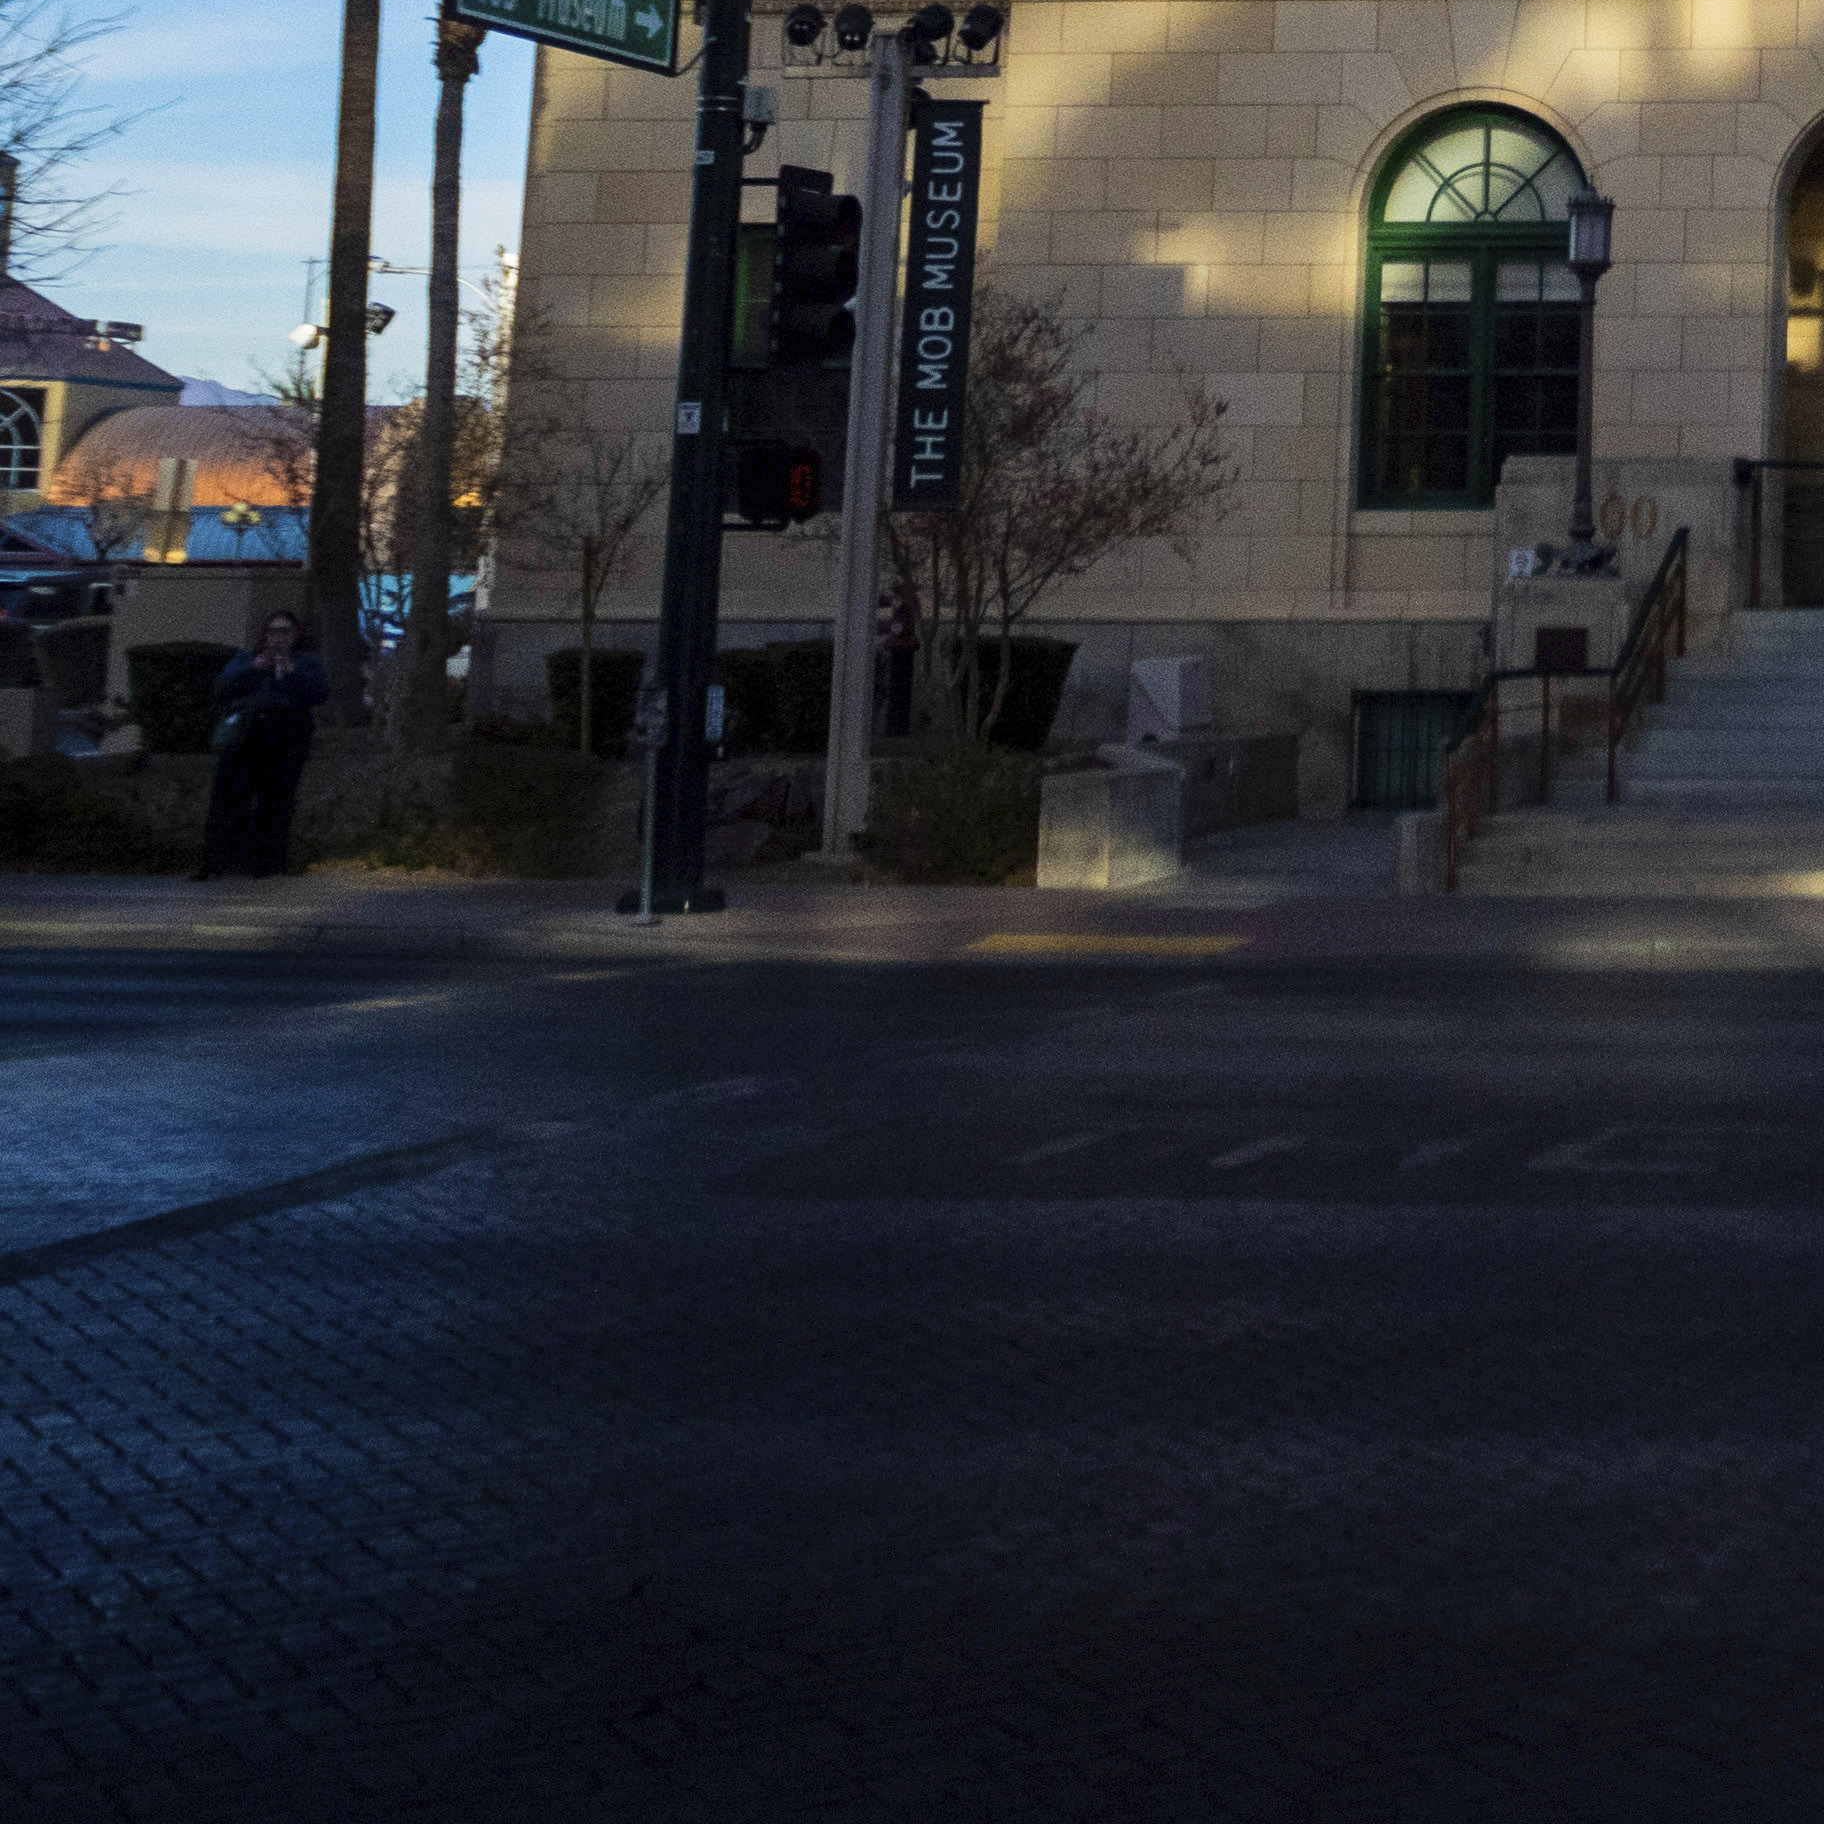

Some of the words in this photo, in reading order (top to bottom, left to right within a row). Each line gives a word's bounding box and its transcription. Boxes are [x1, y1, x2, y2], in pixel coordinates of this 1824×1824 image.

[922, 120, 966, 290] MUSEUM
[916, 305, 955, 391] MOB
[910, 407, 949, 489] THE
